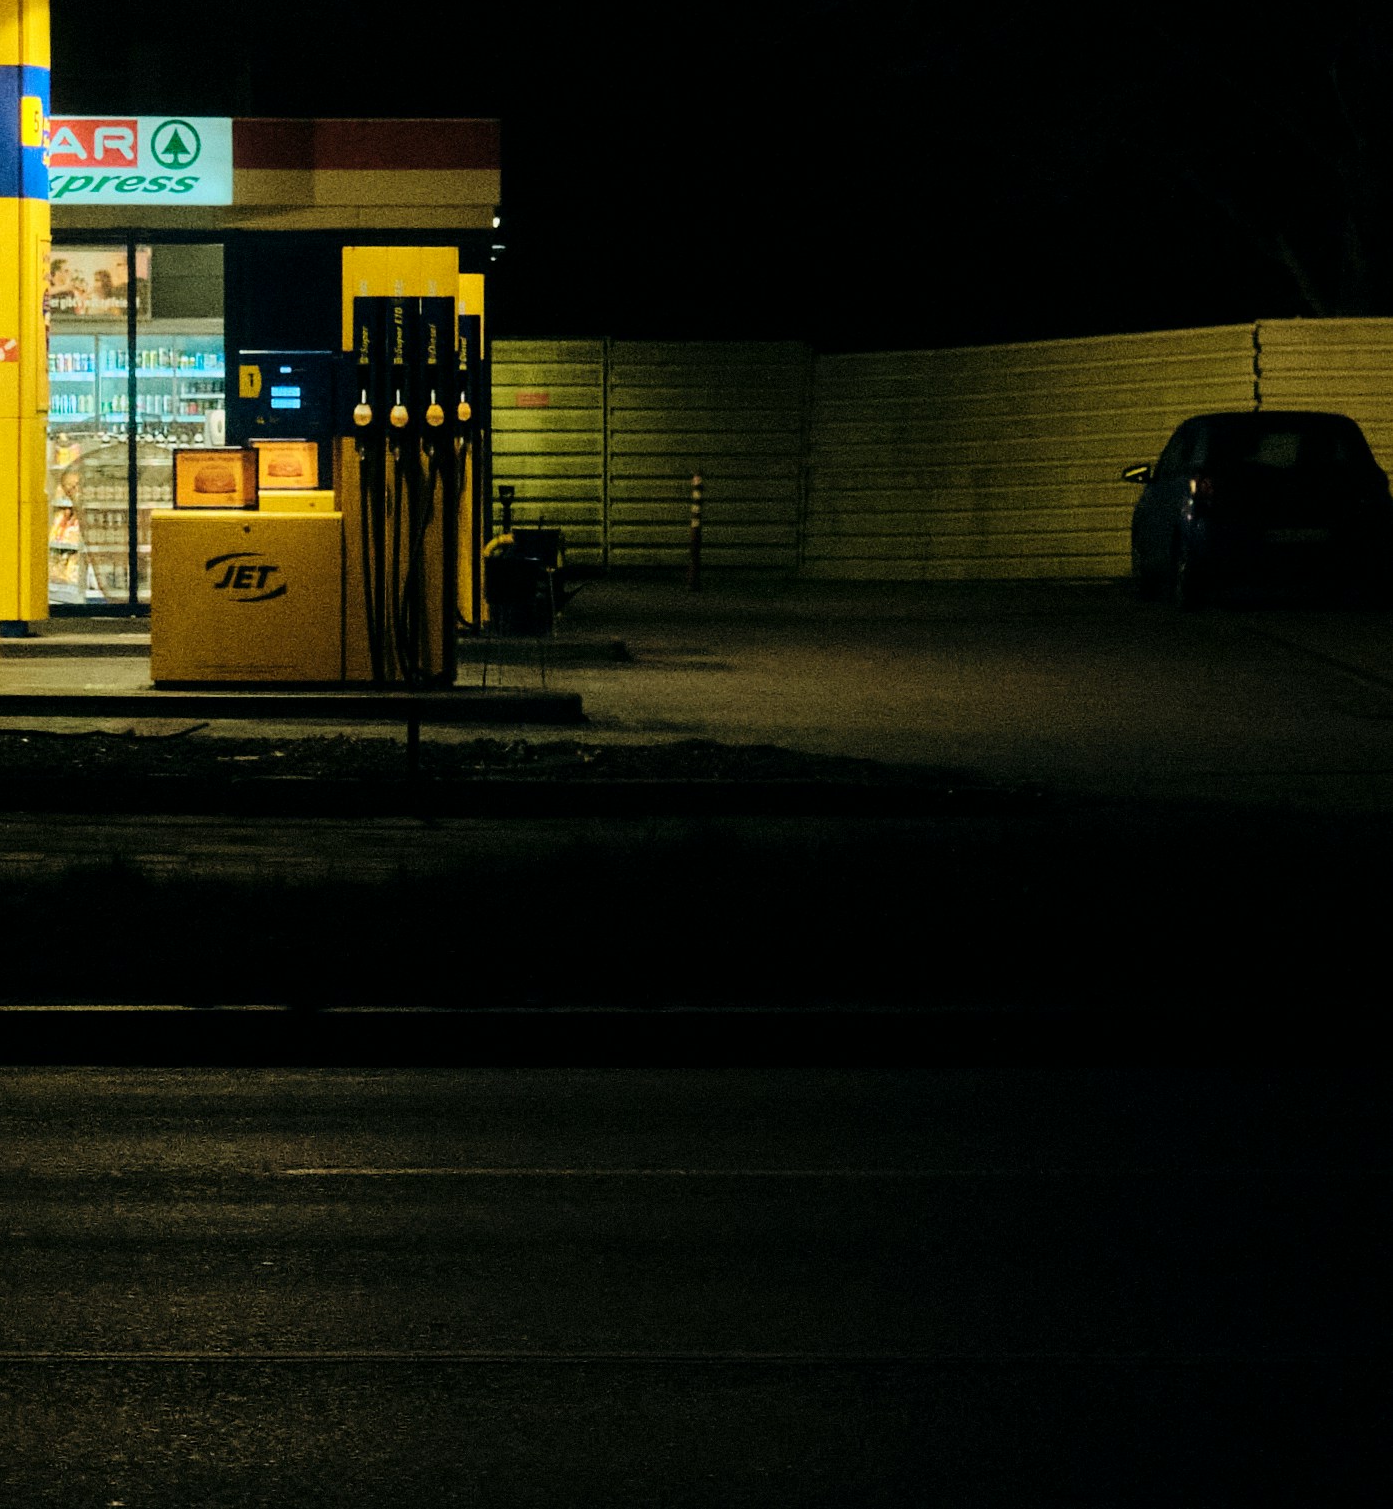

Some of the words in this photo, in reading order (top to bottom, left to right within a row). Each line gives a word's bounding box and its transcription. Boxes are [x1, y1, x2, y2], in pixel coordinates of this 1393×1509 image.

[33, 110, 40, 133] 5
[50, 126, 134, 160] AR
[49, 175, 201, 198] xpress
[214, 565, 279, 589] JET
